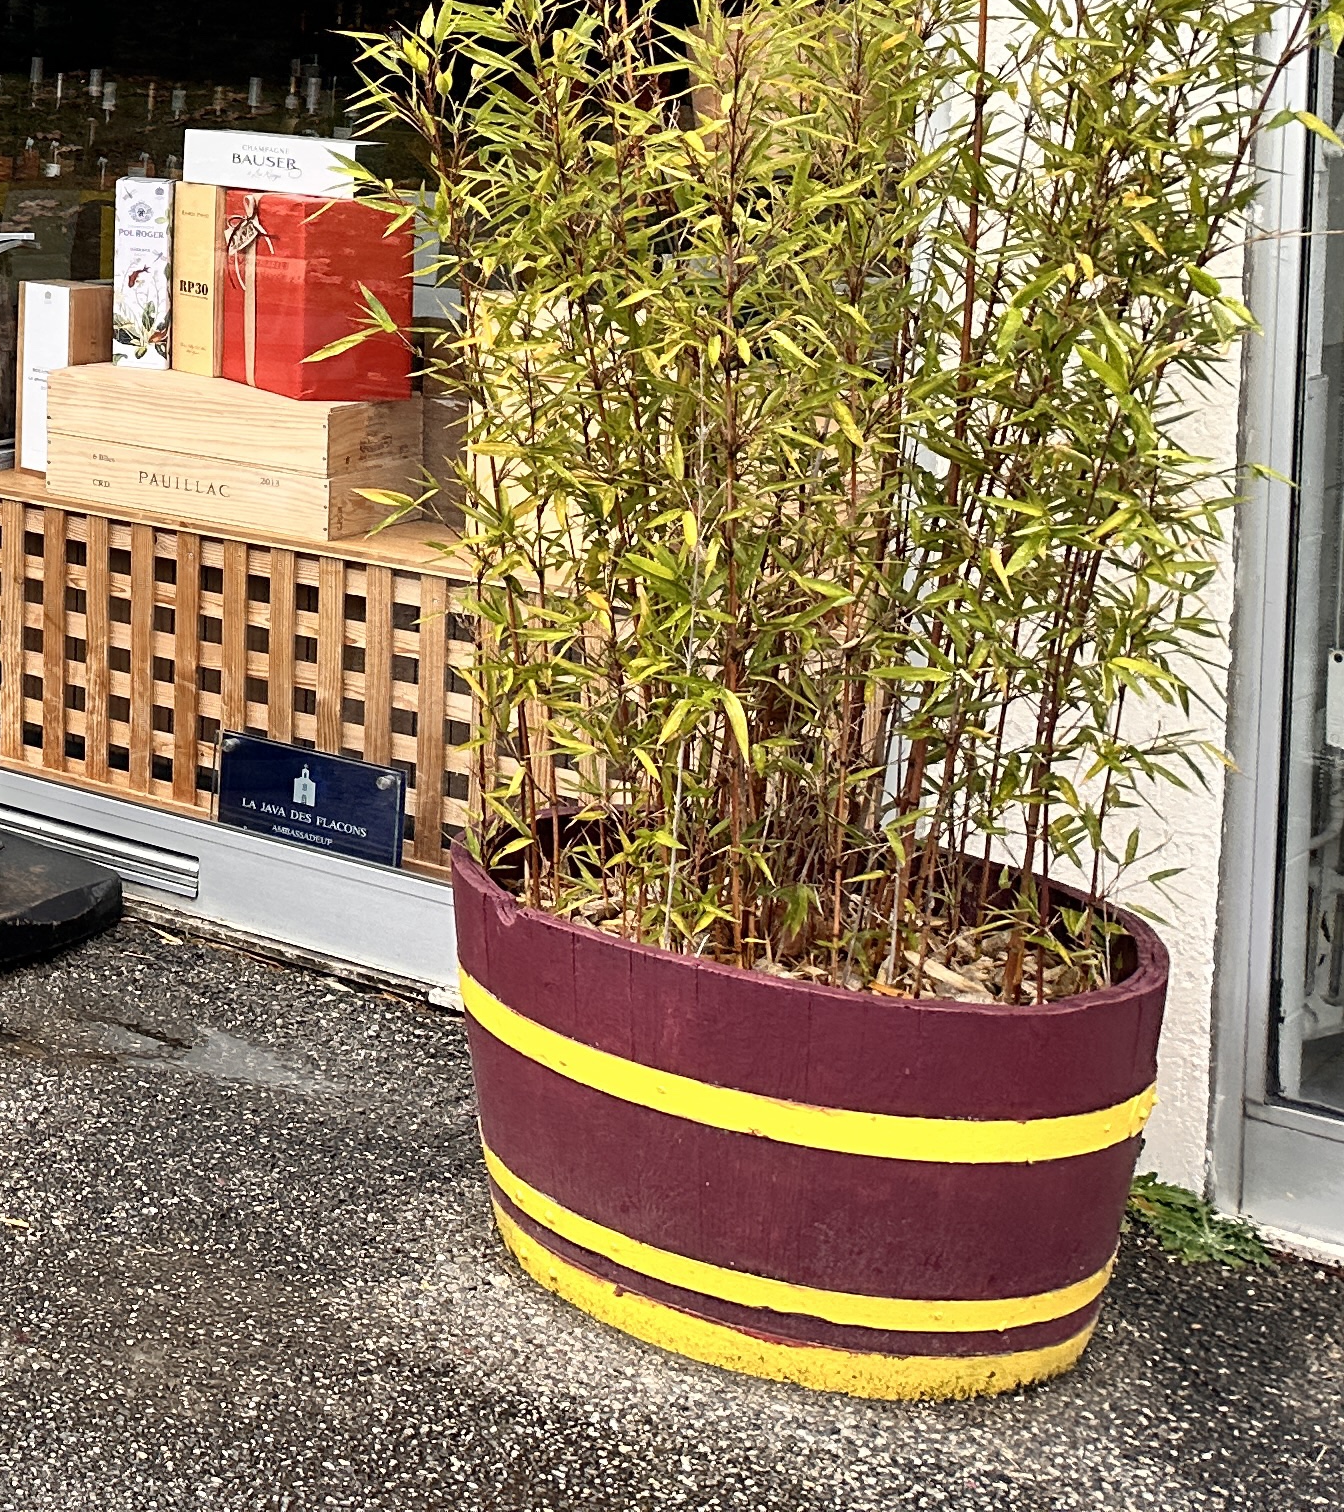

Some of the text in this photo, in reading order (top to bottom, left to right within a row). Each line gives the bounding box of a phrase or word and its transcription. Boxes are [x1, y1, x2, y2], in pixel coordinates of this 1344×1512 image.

[232, 153, 301, 176] BAUSER
[118, 228, 165, 239] POL ROGER
[92, 478, 111, 488] CRD
[138, 470, 231, 498] PAUILLAC
[260, 477, 280, 488] 2013
[241, 796, 367, 838] LA JAVA DES FLACONS
